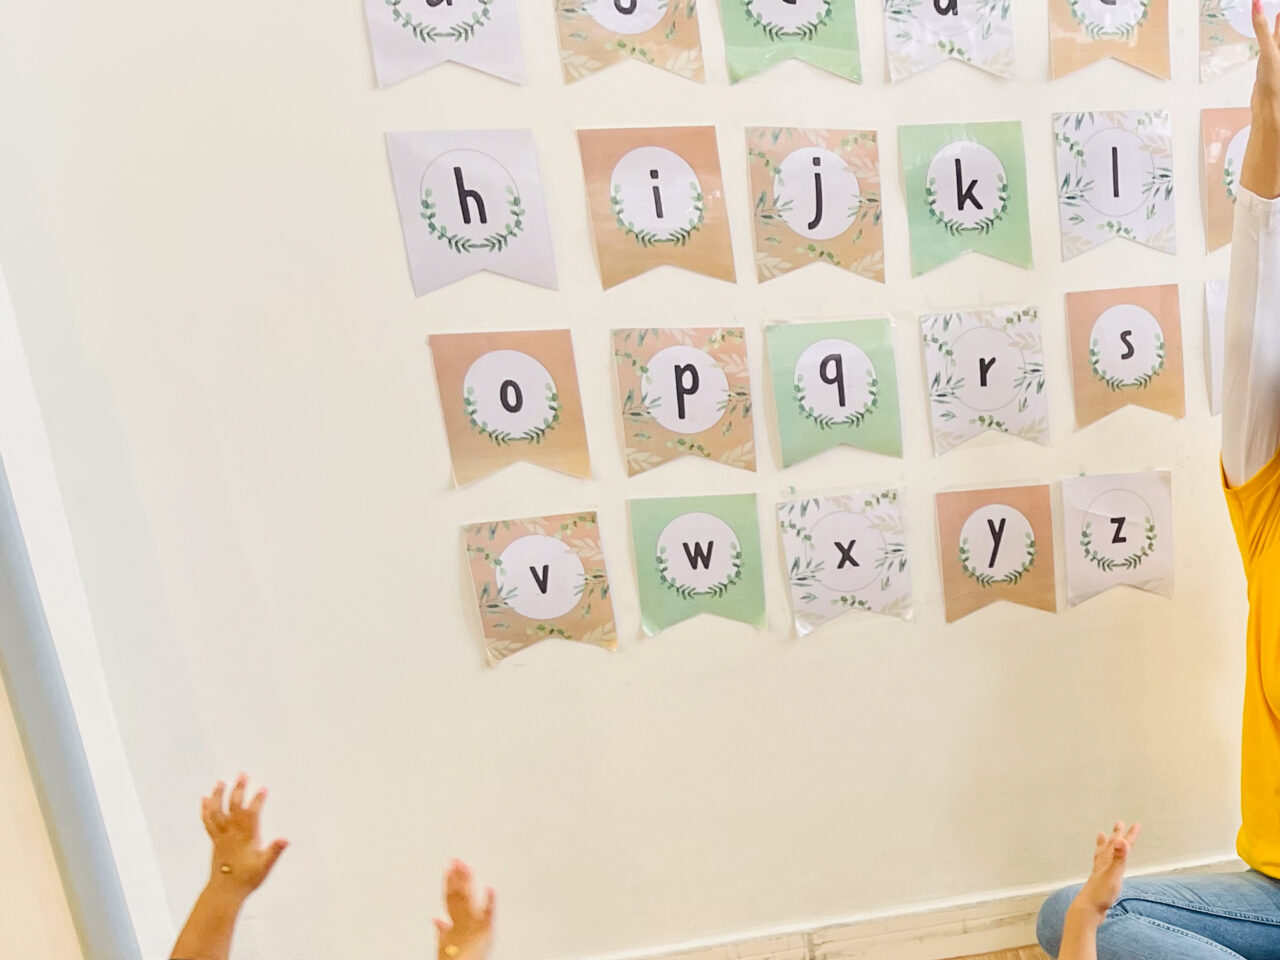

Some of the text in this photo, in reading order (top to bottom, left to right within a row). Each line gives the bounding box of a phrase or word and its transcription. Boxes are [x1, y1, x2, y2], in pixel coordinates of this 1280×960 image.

[454, 167, 487, 224] h
[649, 169, 664, 219] i
[807, 156, 823, 230] j
[955, 159, 983, 210] k
[1112, 147, 1119, 197] l
[1120, 330, 1135, 360] s
[500, 380, 522, 412] o
[675, 364, 699, 419] p
[820, 355, 845, 406] q
[979, 357, 996, 386] r
[834, 540, 860, 570] x
[987, 518, 1006, 569] y
[1110, 516, 1127, 544] z
[529, 565, 549, 594] v
[682, 541, 713, 570] w
